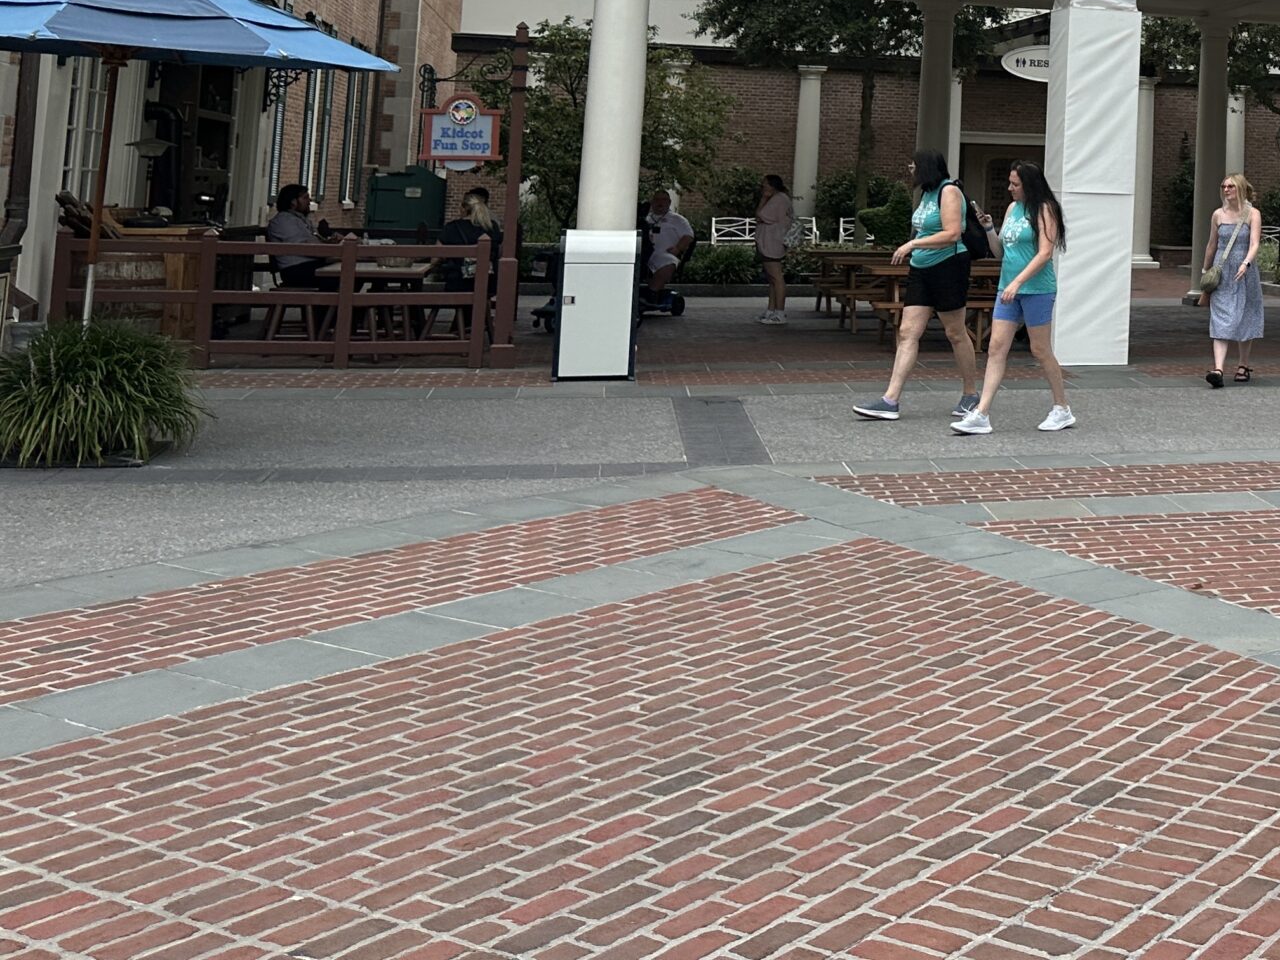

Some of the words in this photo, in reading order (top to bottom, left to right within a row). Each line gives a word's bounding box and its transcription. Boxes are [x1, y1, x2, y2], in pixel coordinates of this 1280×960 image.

[440, 127, 484, 138] Kidcot
[432, 139, 458, 150] Fun
[461, 140, 490, 153] Stop
